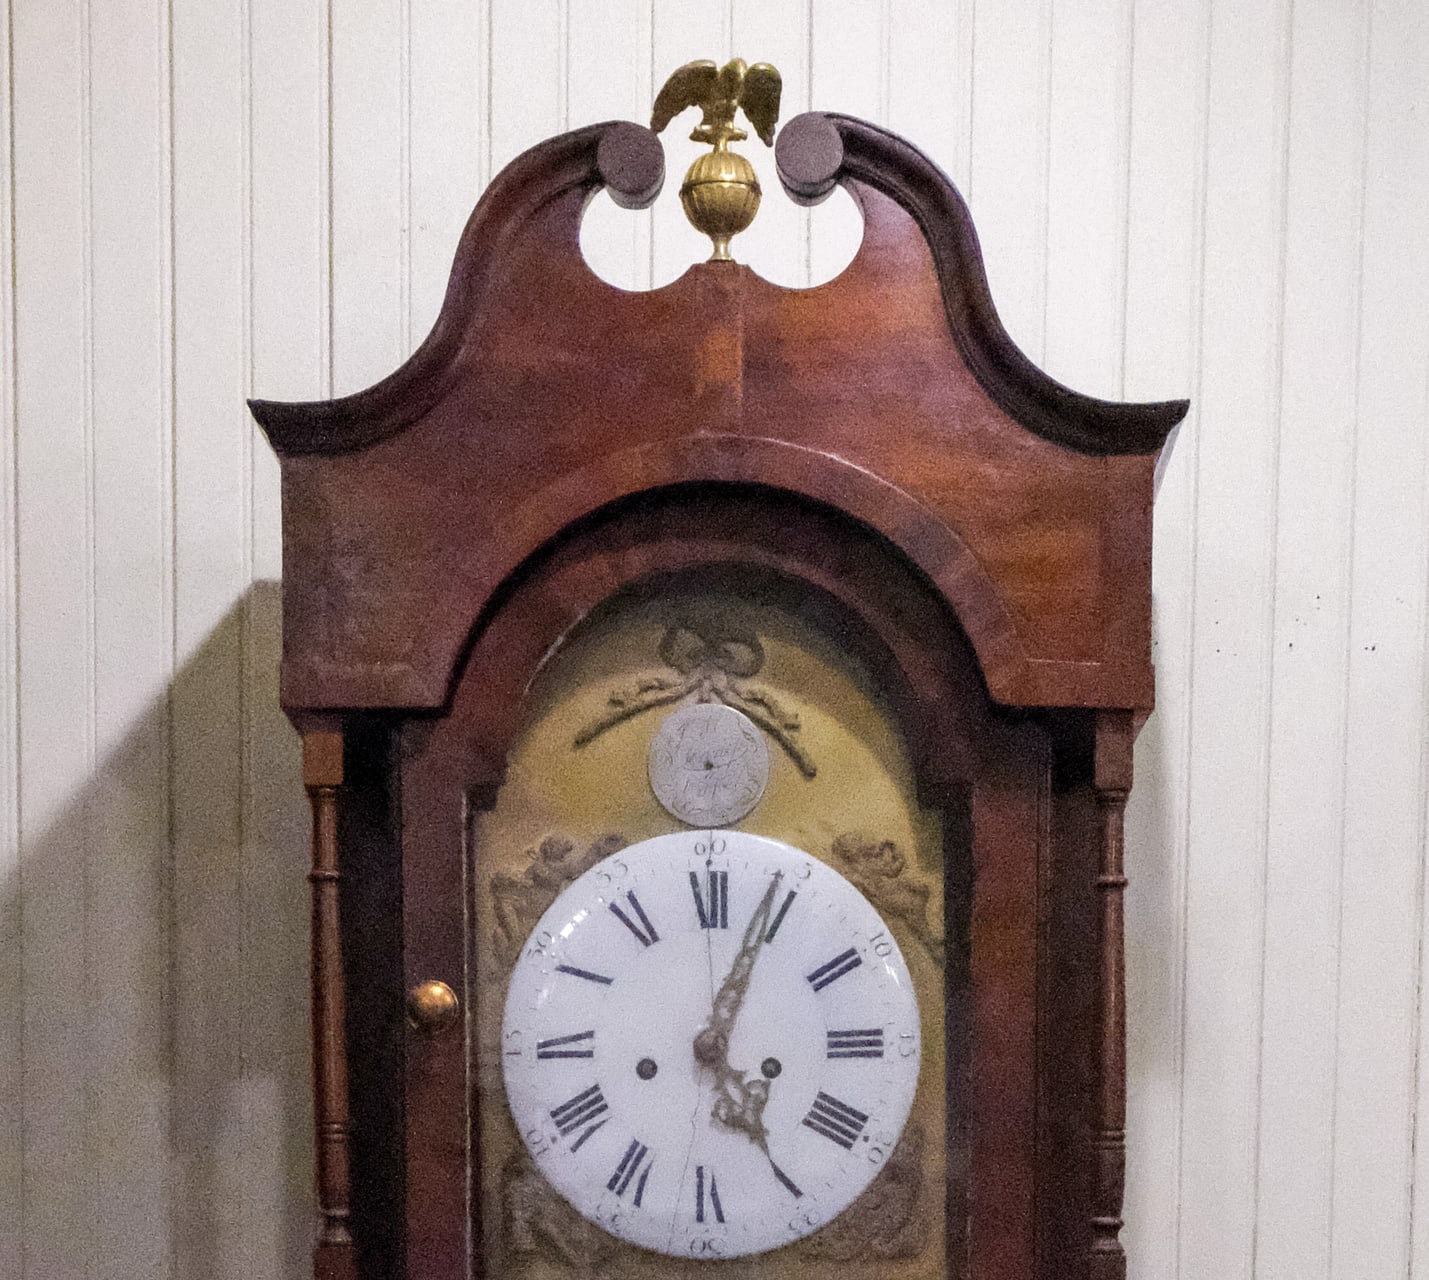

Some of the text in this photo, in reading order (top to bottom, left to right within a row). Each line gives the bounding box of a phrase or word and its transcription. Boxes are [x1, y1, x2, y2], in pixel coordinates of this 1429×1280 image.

[764, 889, 799, 945] I
[869, 931, 894, 959] 10
[806, 946, 864, 993] II
[826, 1028, 885, 1060] III
[801, 1089, 870, 1151] IIII
